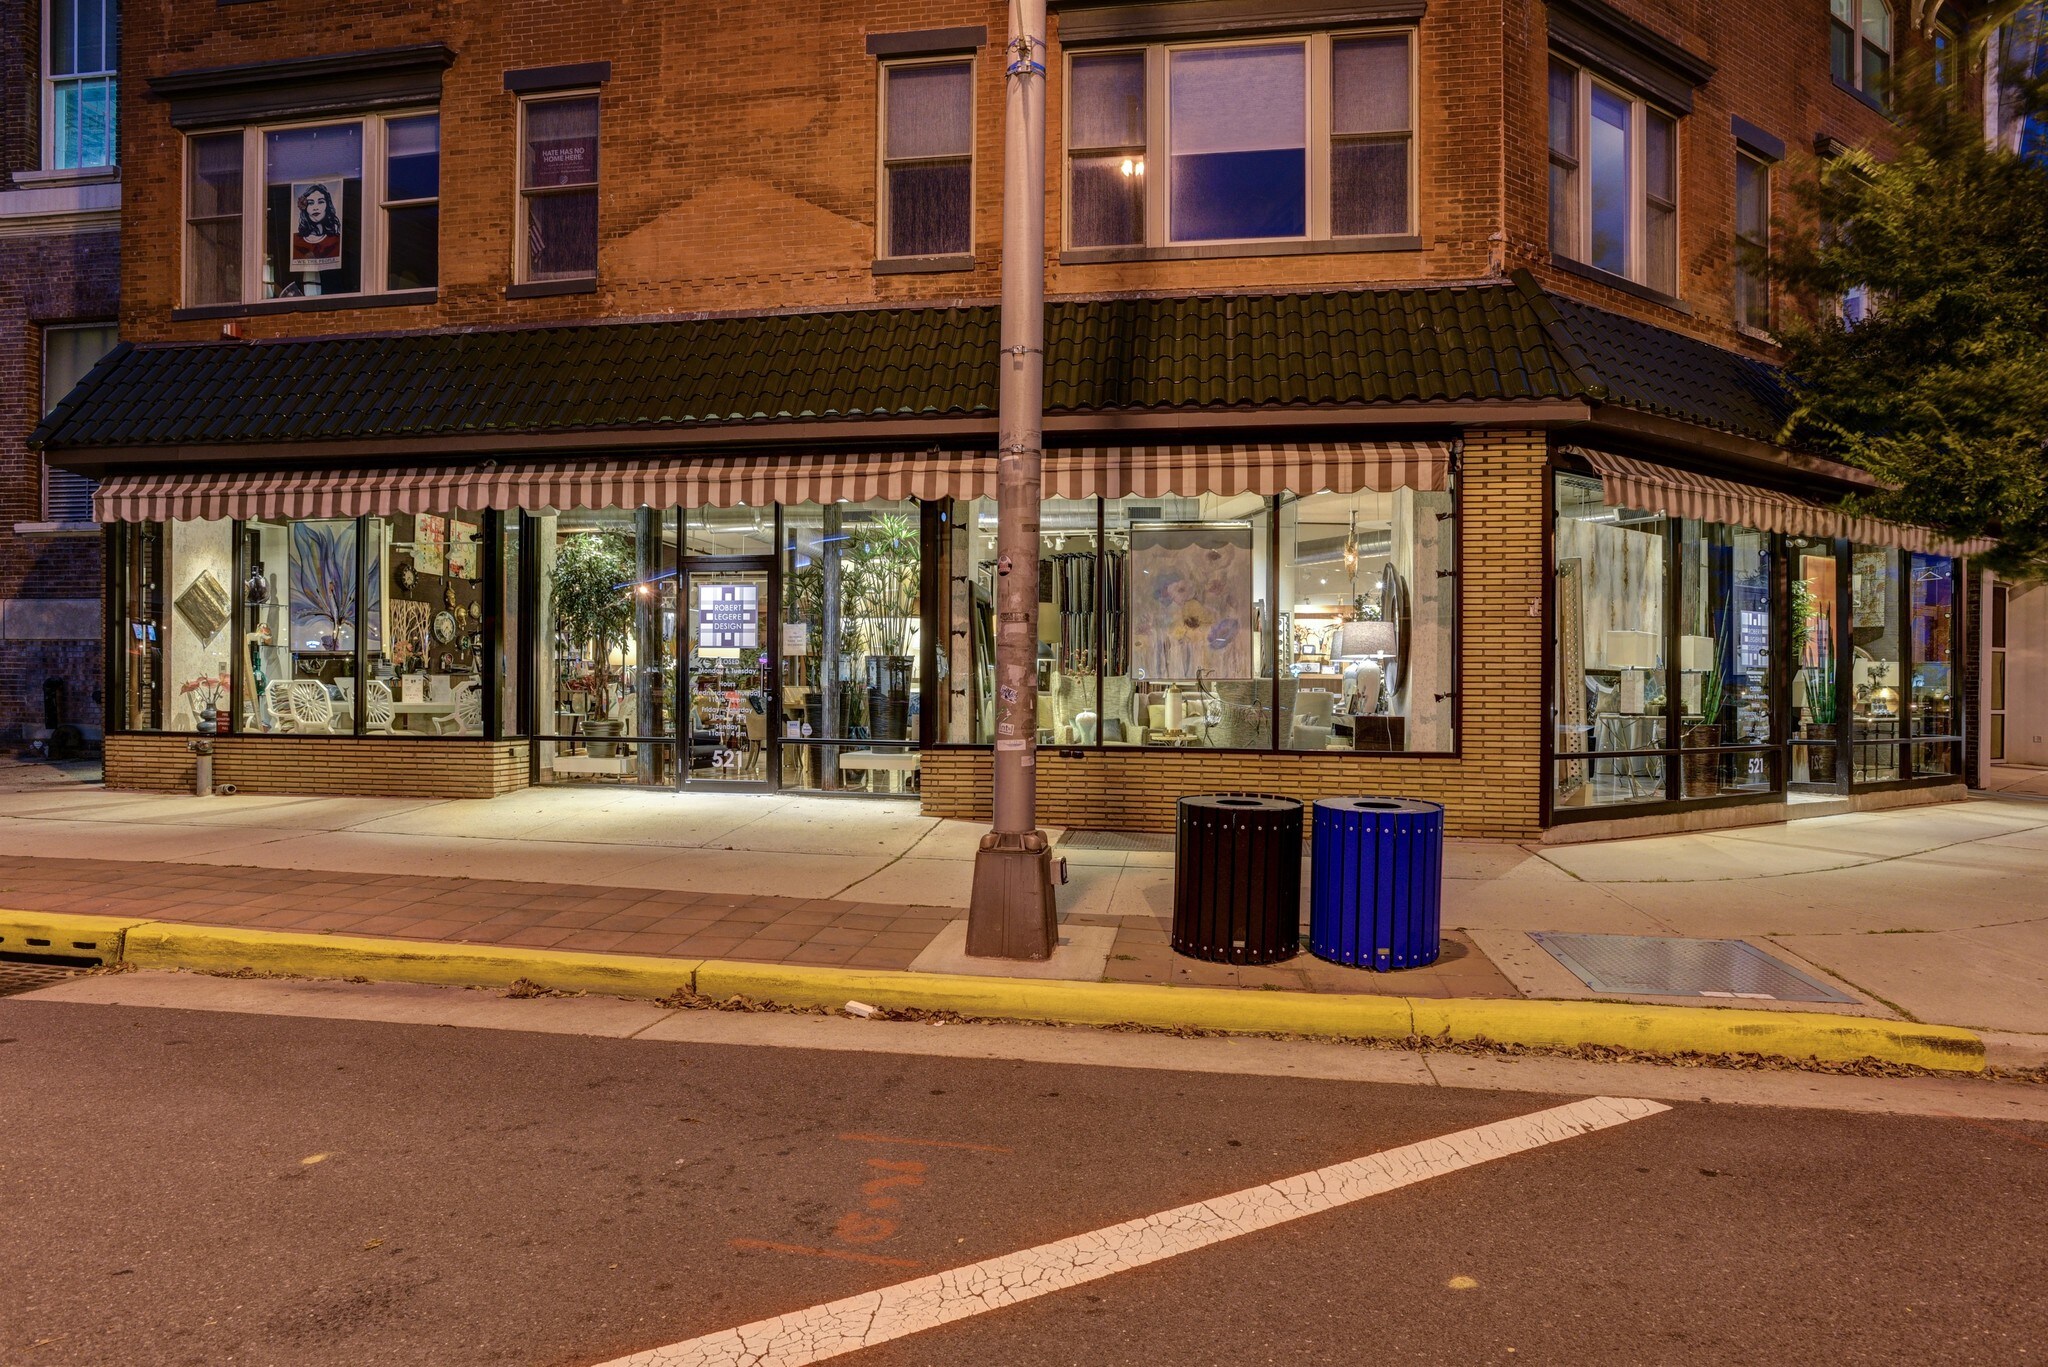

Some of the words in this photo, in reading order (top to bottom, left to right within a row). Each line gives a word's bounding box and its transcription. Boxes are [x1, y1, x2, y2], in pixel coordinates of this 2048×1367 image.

[714, 613, 742, 621] LEGERE
[698, 667, 723, 675] Monday
[731, 667, 757, 675] Tuesday
[711, 749, 743, 768] 521
[1748, 758, 1764, 774] 521
